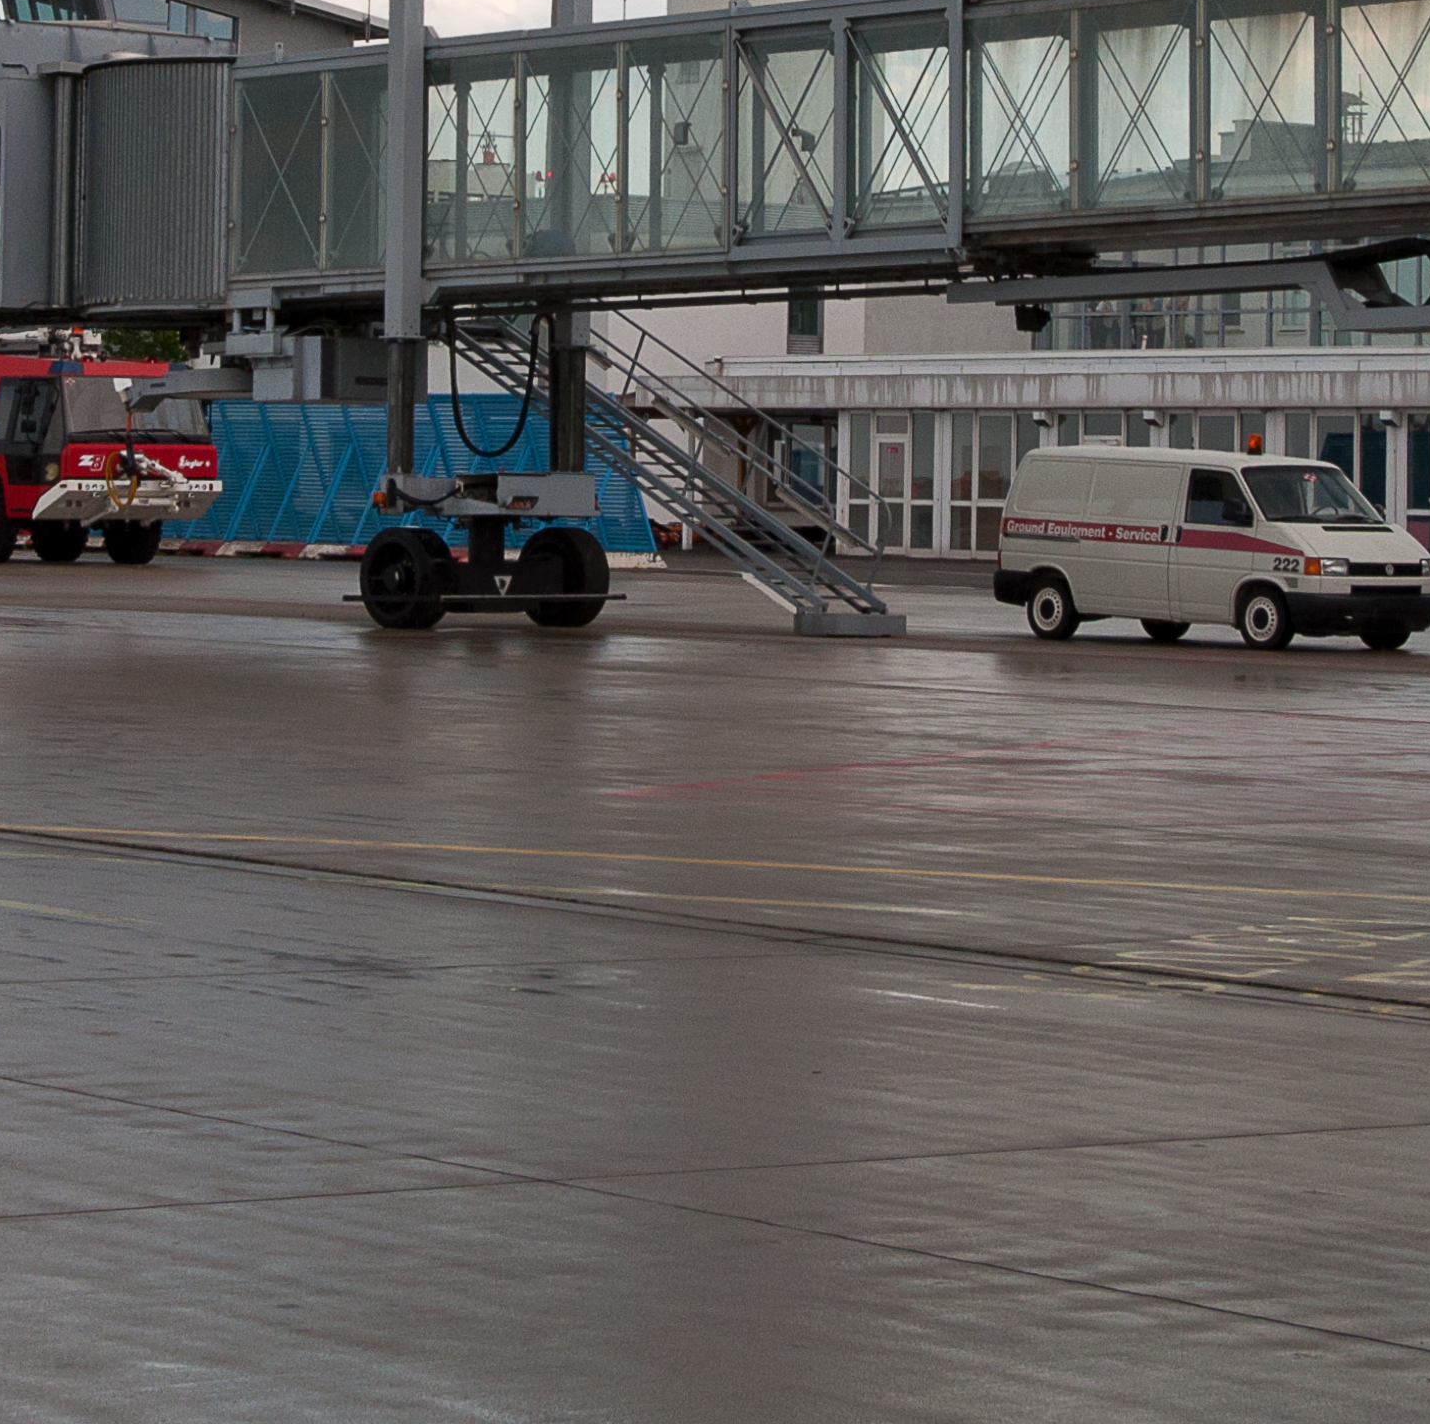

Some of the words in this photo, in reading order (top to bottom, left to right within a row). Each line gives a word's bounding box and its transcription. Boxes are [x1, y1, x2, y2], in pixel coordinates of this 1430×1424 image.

[78, 454, 106, 472] Z8
[1007, 520, 1045, 534] Ground
[1115, 526, 1159, 542] Service
[1273, 556, 1300, 573] 222
